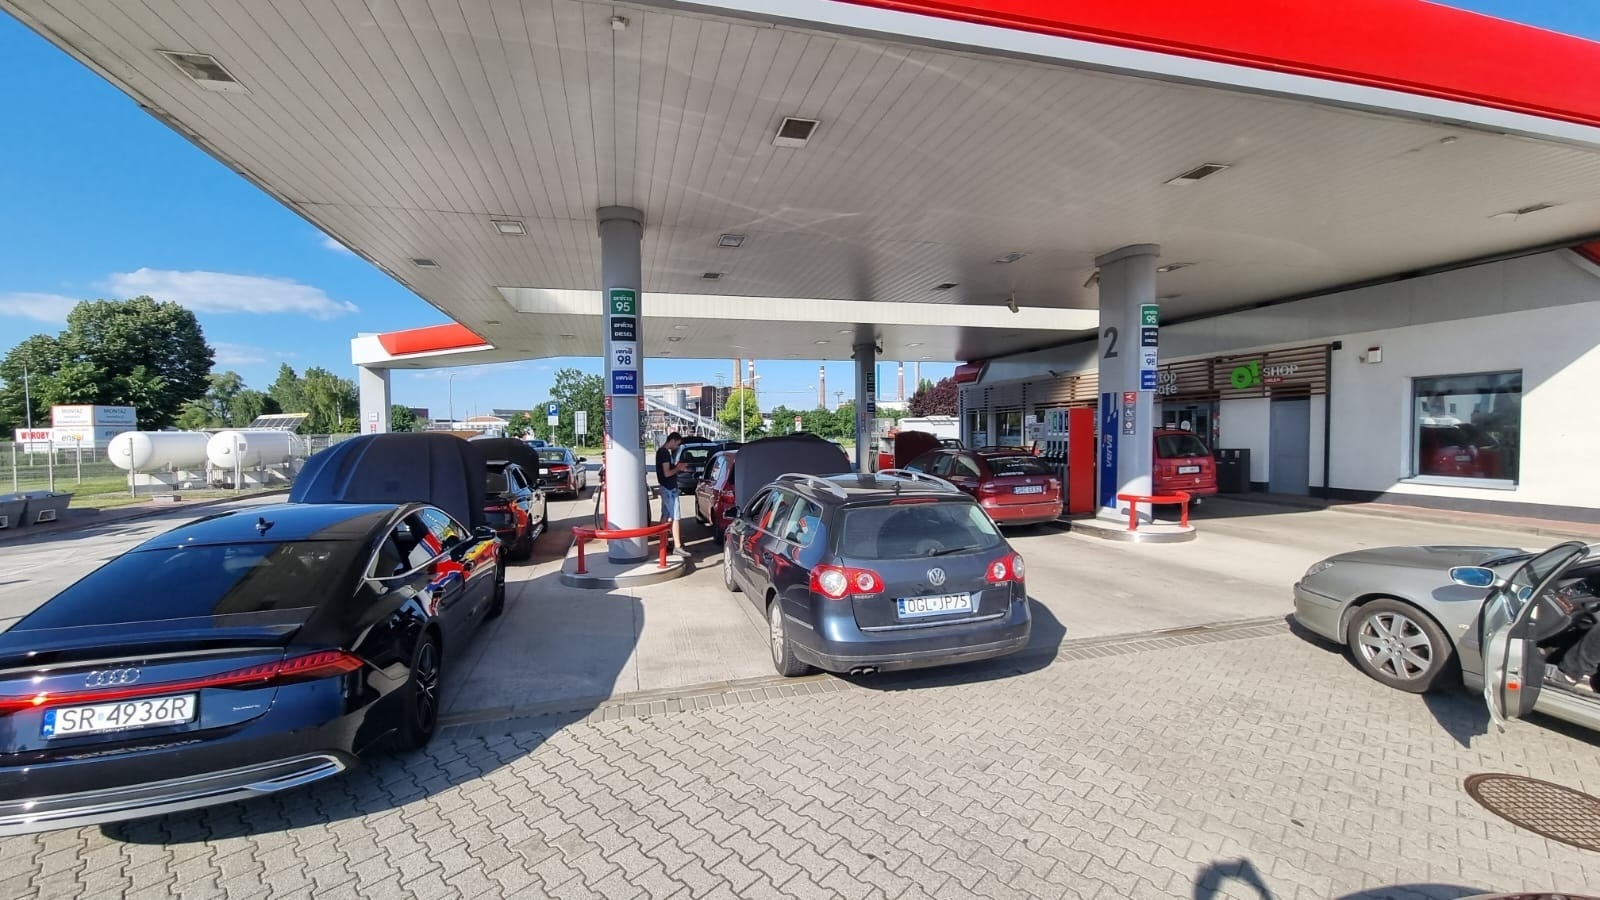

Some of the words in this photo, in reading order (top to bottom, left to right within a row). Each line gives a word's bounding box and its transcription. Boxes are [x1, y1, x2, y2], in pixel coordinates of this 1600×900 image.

[616, 302, 630, 312] 95
[1146, 315, 1156, 323] 95
[1104, 327, 1118, 358] 2
[617, 355, 632, 365] 98
[1263, 365, 1299, 377] SHOP
[550, 405, 557, 414] P
[21, 431, 49, 440] WYROBY
[907, 597, 932, 613] OGL
[938, 594, 968, 610] JP75
[61, 707, 95, 731] SR
[105, 697, 187, 726] 4936R
